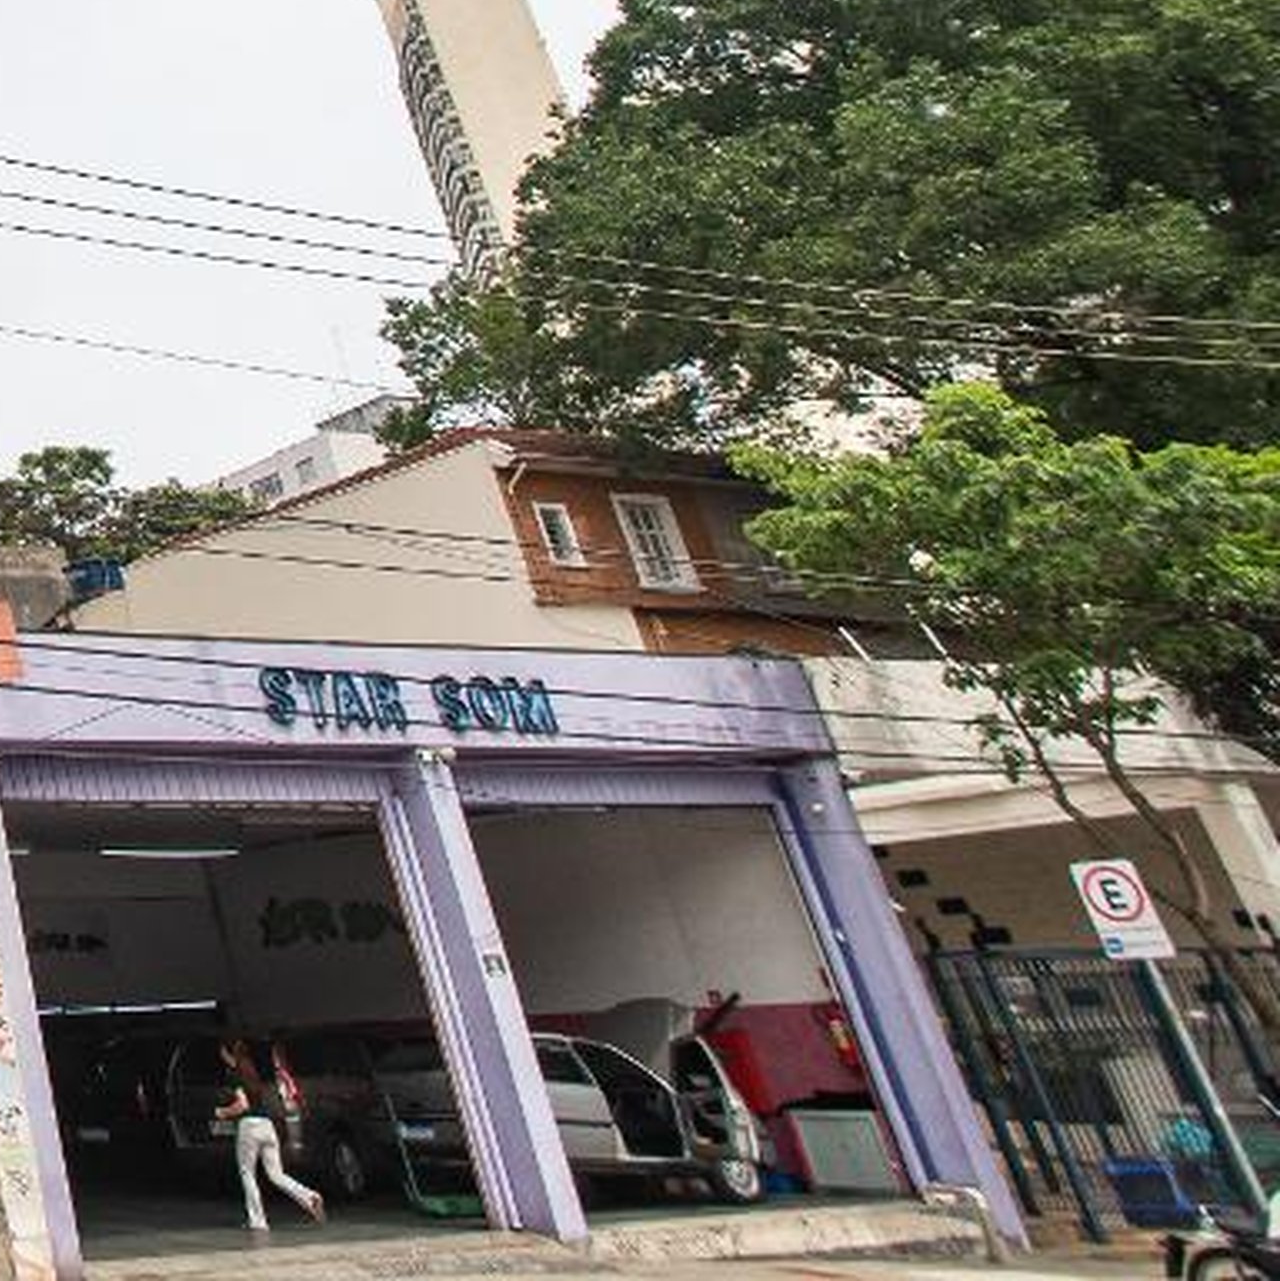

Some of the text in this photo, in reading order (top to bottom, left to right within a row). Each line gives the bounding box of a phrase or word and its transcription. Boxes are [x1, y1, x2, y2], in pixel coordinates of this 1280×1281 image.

[258, 665, 559, 736] STAR SOM
[1099, 878, 1128, 910] E
